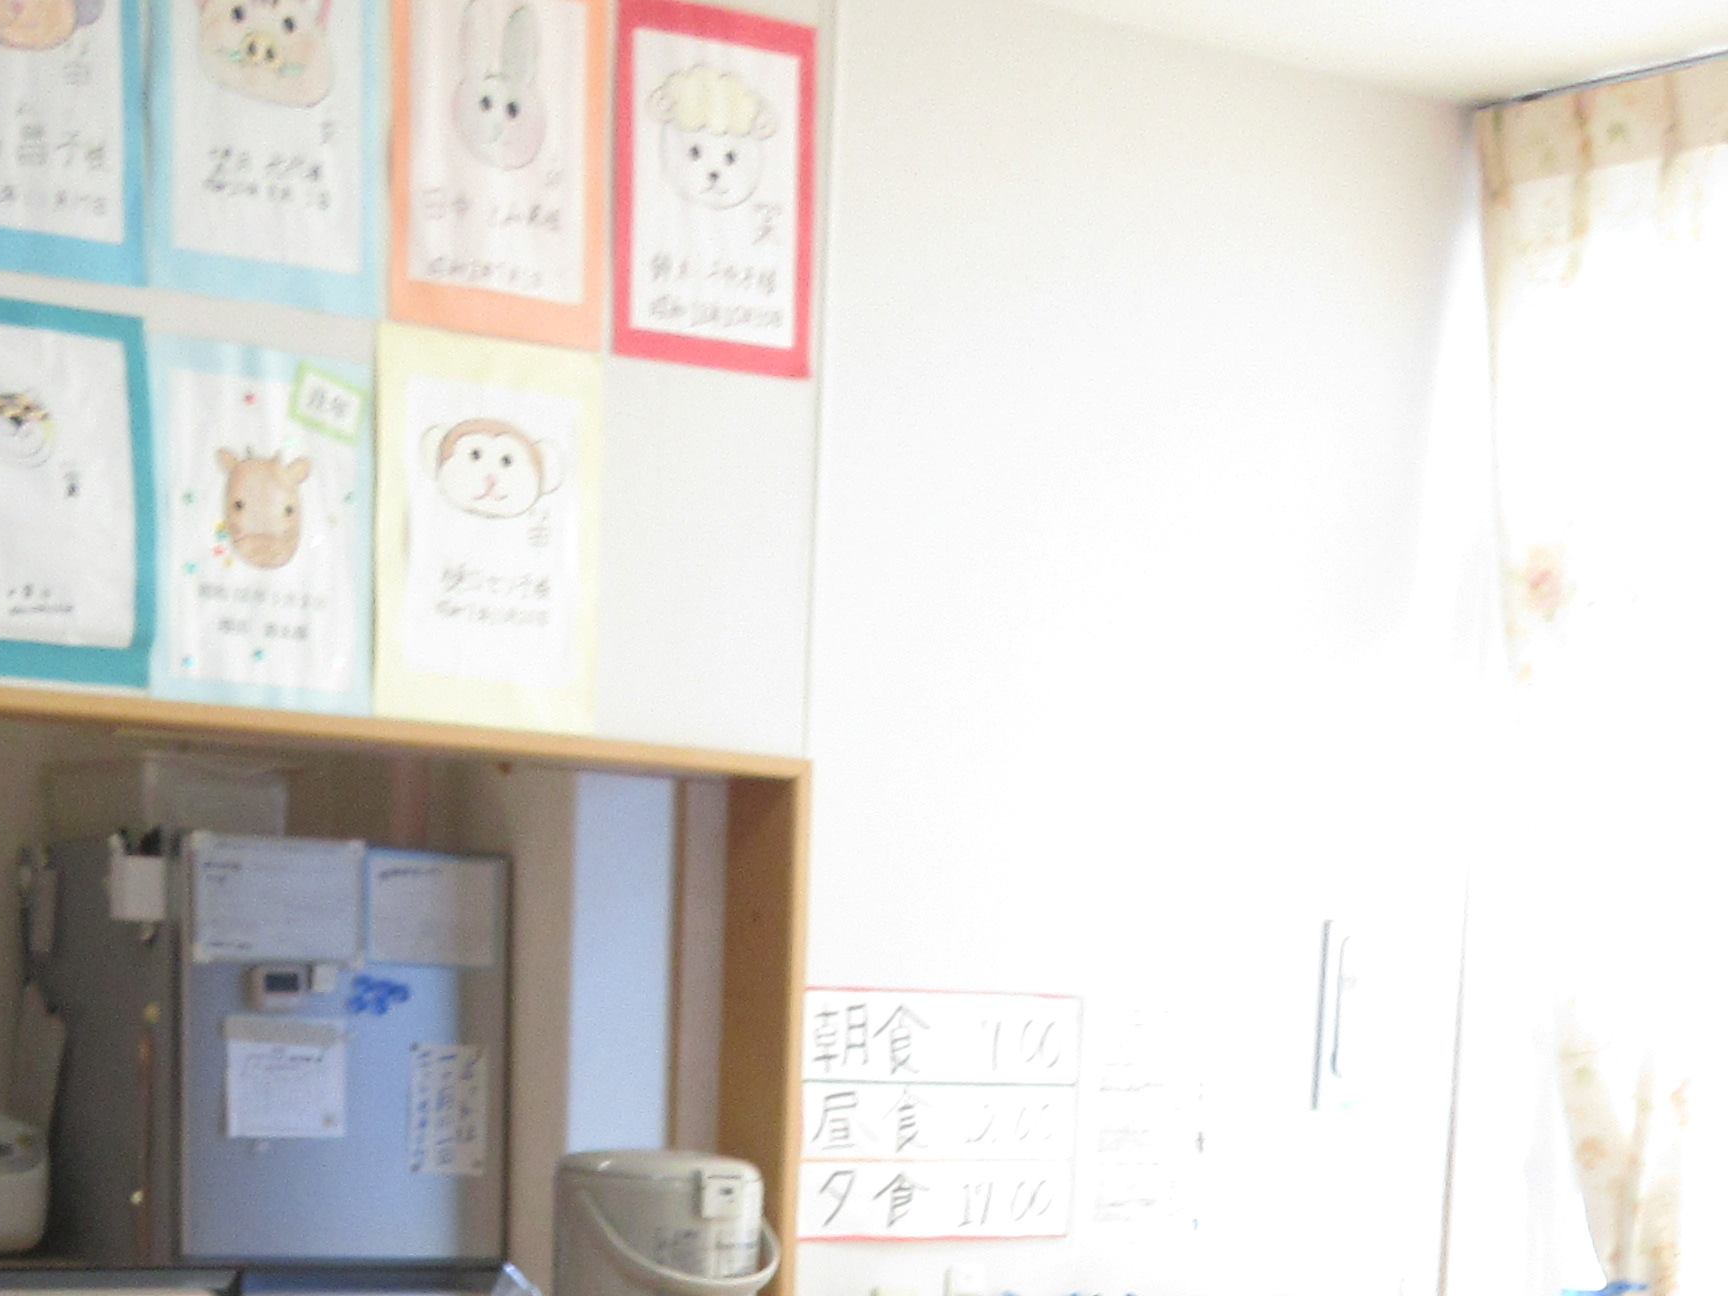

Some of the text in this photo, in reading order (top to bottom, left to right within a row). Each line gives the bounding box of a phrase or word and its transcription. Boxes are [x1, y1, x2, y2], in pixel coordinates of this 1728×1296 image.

[811, 1000, 932, 1076] 朝食
[811, 1083, 934, 1154] 昼食
[817, 1168, 931, 1230] 夕食
